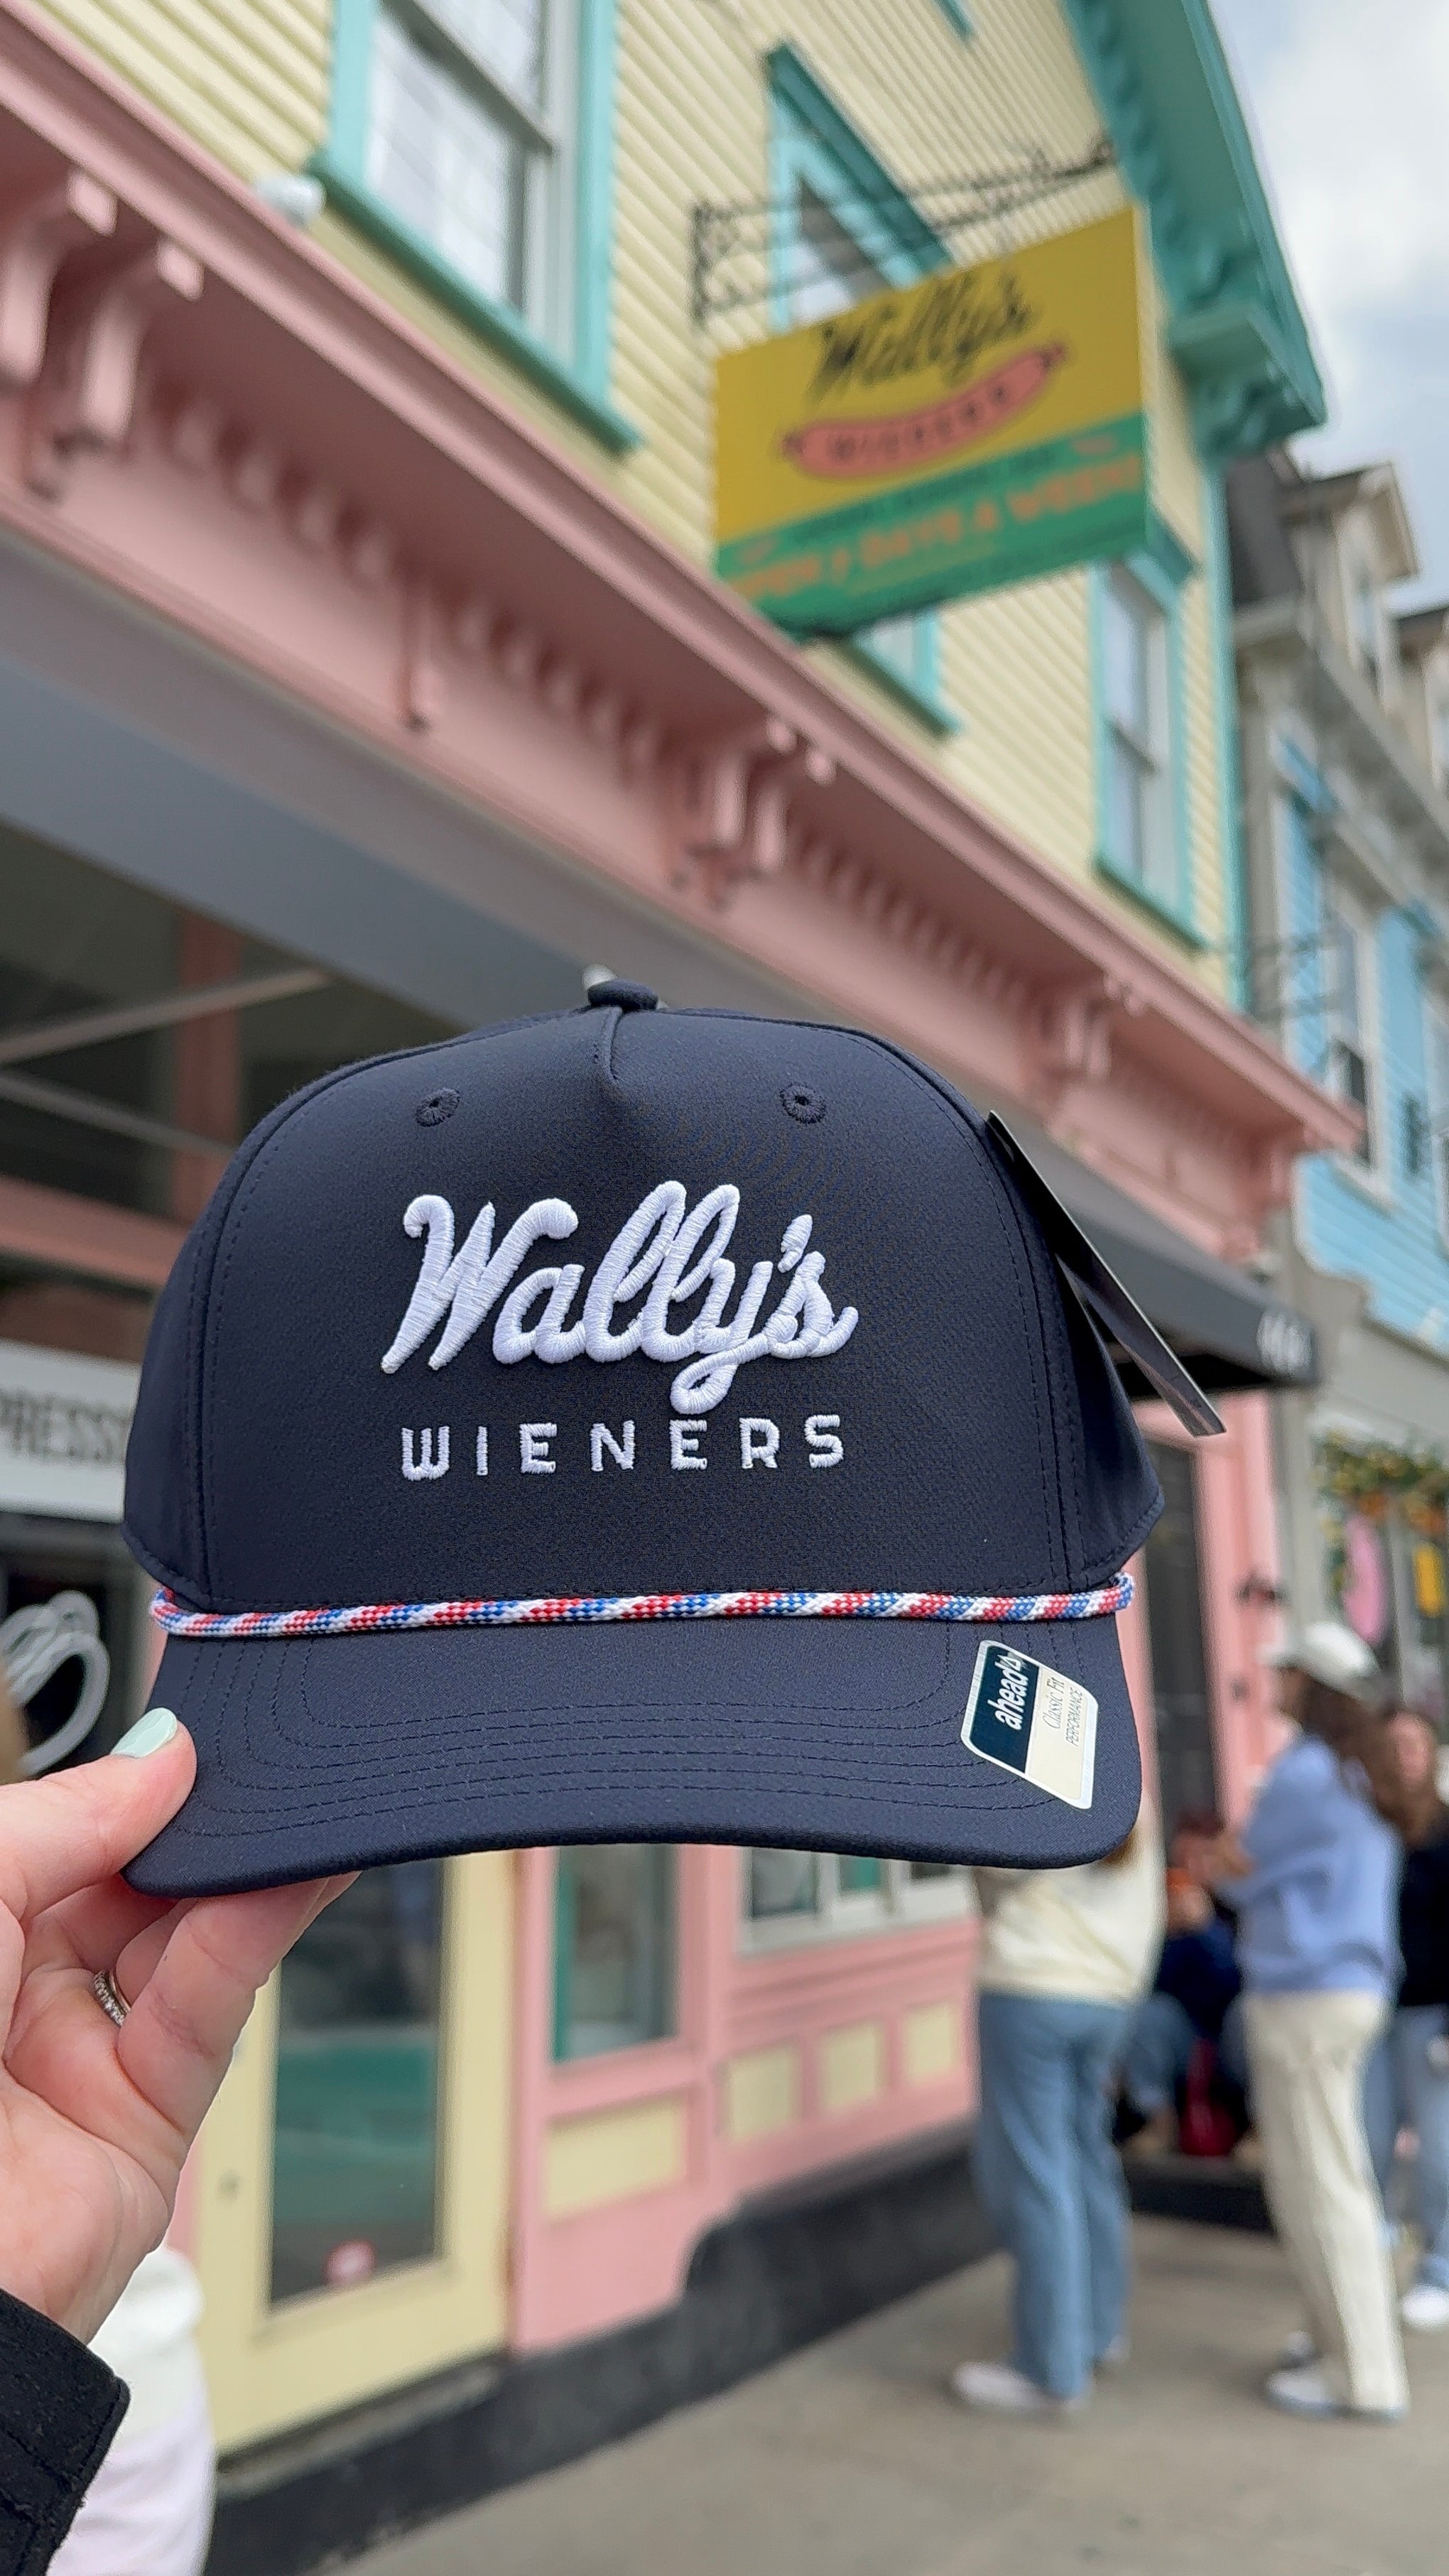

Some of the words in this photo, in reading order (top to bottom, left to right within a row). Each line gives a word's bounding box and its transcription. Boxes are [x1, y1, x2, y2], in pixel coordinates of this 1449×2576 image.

[381, 1180, 859, 1415] Wally's
[401, 1415, 843, 1482] WIENERS
[987, 1661, 1029, 1730] ahead
[1042, 1692, 1063, 1729] Classic
[1046, 1677, 1065, 1695] Fit
[1065, 1687, 1082, 1746] PERFORMANCE
